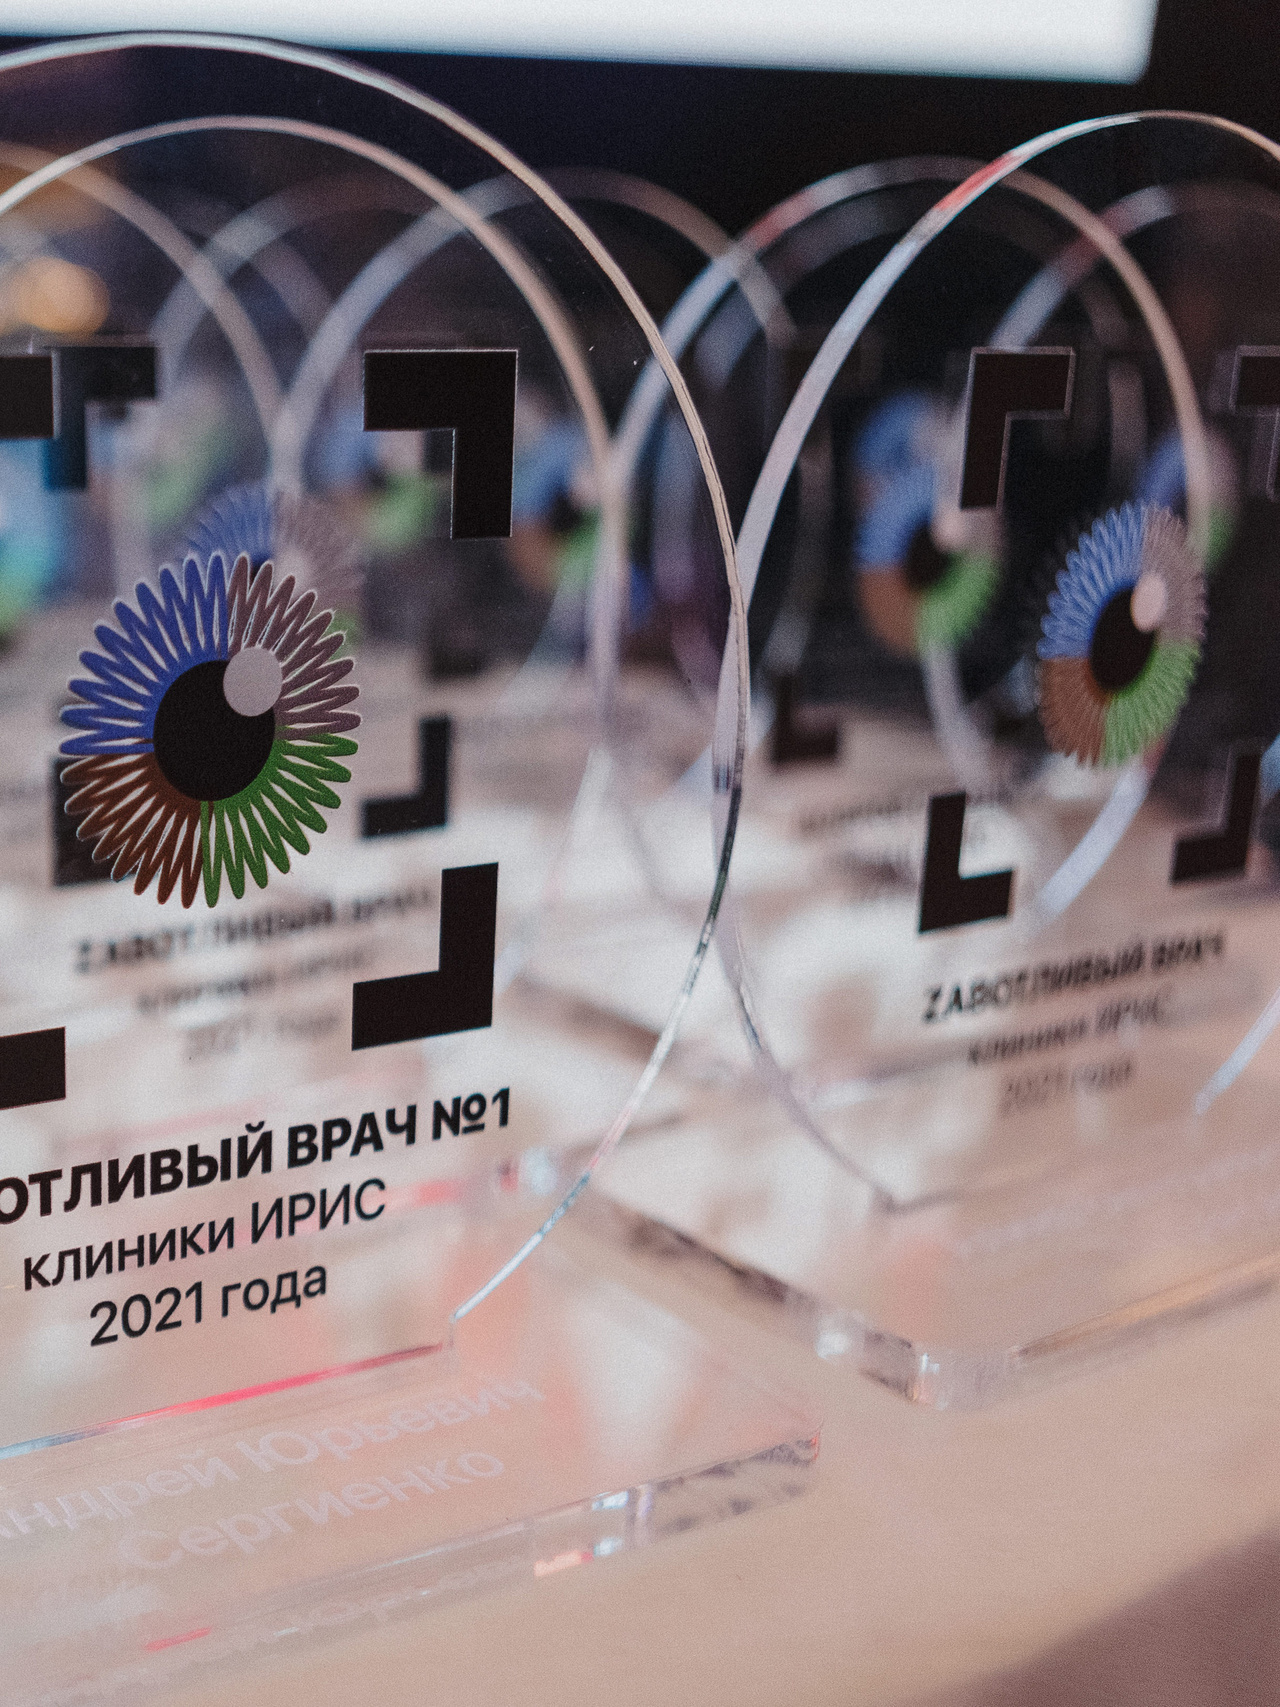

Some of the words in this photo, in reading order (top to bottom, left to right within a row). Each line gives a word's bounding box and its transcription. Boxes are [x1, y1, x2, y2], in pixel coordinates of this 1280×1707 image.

[286, 1104, 419, 1170] ВРАЧ
[431, 1087, 511, 1140] №1
[22, 1217, 236, 1292] клиники
[250, 1178, 387, 1245] ИРИС
[89, 1280, 204, 1348] 2021
[220, 1264, 328, 1318] года
[236, 1377, 545, 1473] Юрьевич
[119, 1449, 505, 1568] Сергиенко
